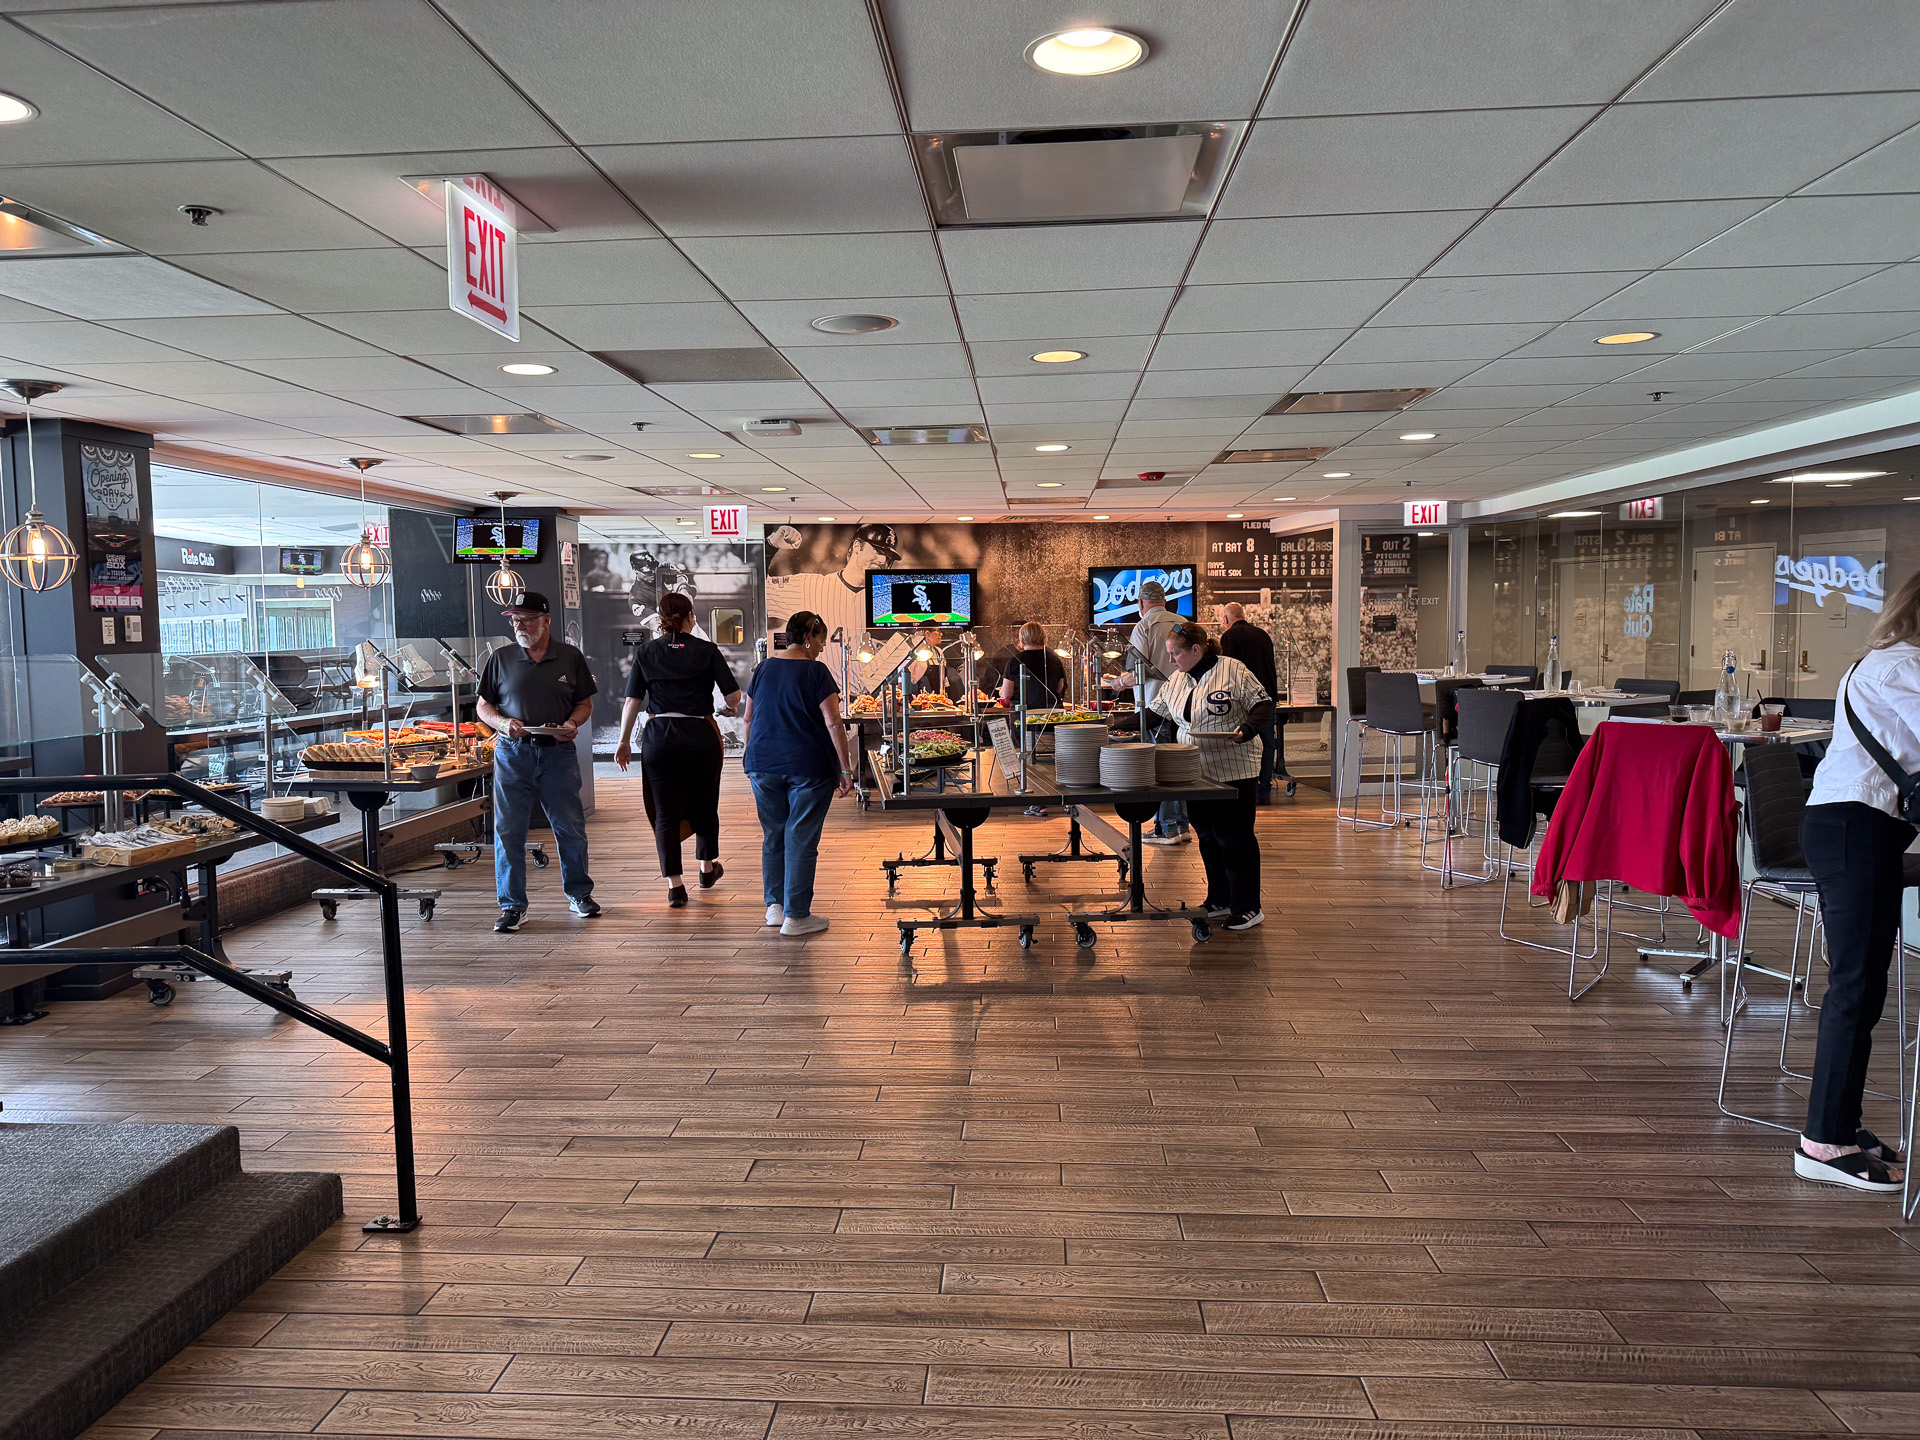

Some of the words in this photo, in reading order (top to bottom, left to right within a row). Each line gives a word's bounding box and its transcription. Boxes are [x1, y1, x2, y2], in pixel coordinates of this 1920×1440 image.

[464, 206, 505, 304] EXIT
[91, 469, 129, 489] Opening
[103, 488, 119, 497] DAY
[711, 509, 739, 530] EXIT
[1412, 504, 1440, 524] EXIT
[1212, 543, 1223, 552] AT
[1225, 542, 1242, 552] BAT
[1246, 538, 1255, 552] 8
[1281, 542, 1303, 552] BALL
[1382, 541, 1399, 551] OUT
[1402, 537, 1410, 551] 2
[181, 548, 199, 565] Rate
[199, 552, 215, 566] Club
[1422, 597, 1440, 605] EXIT
